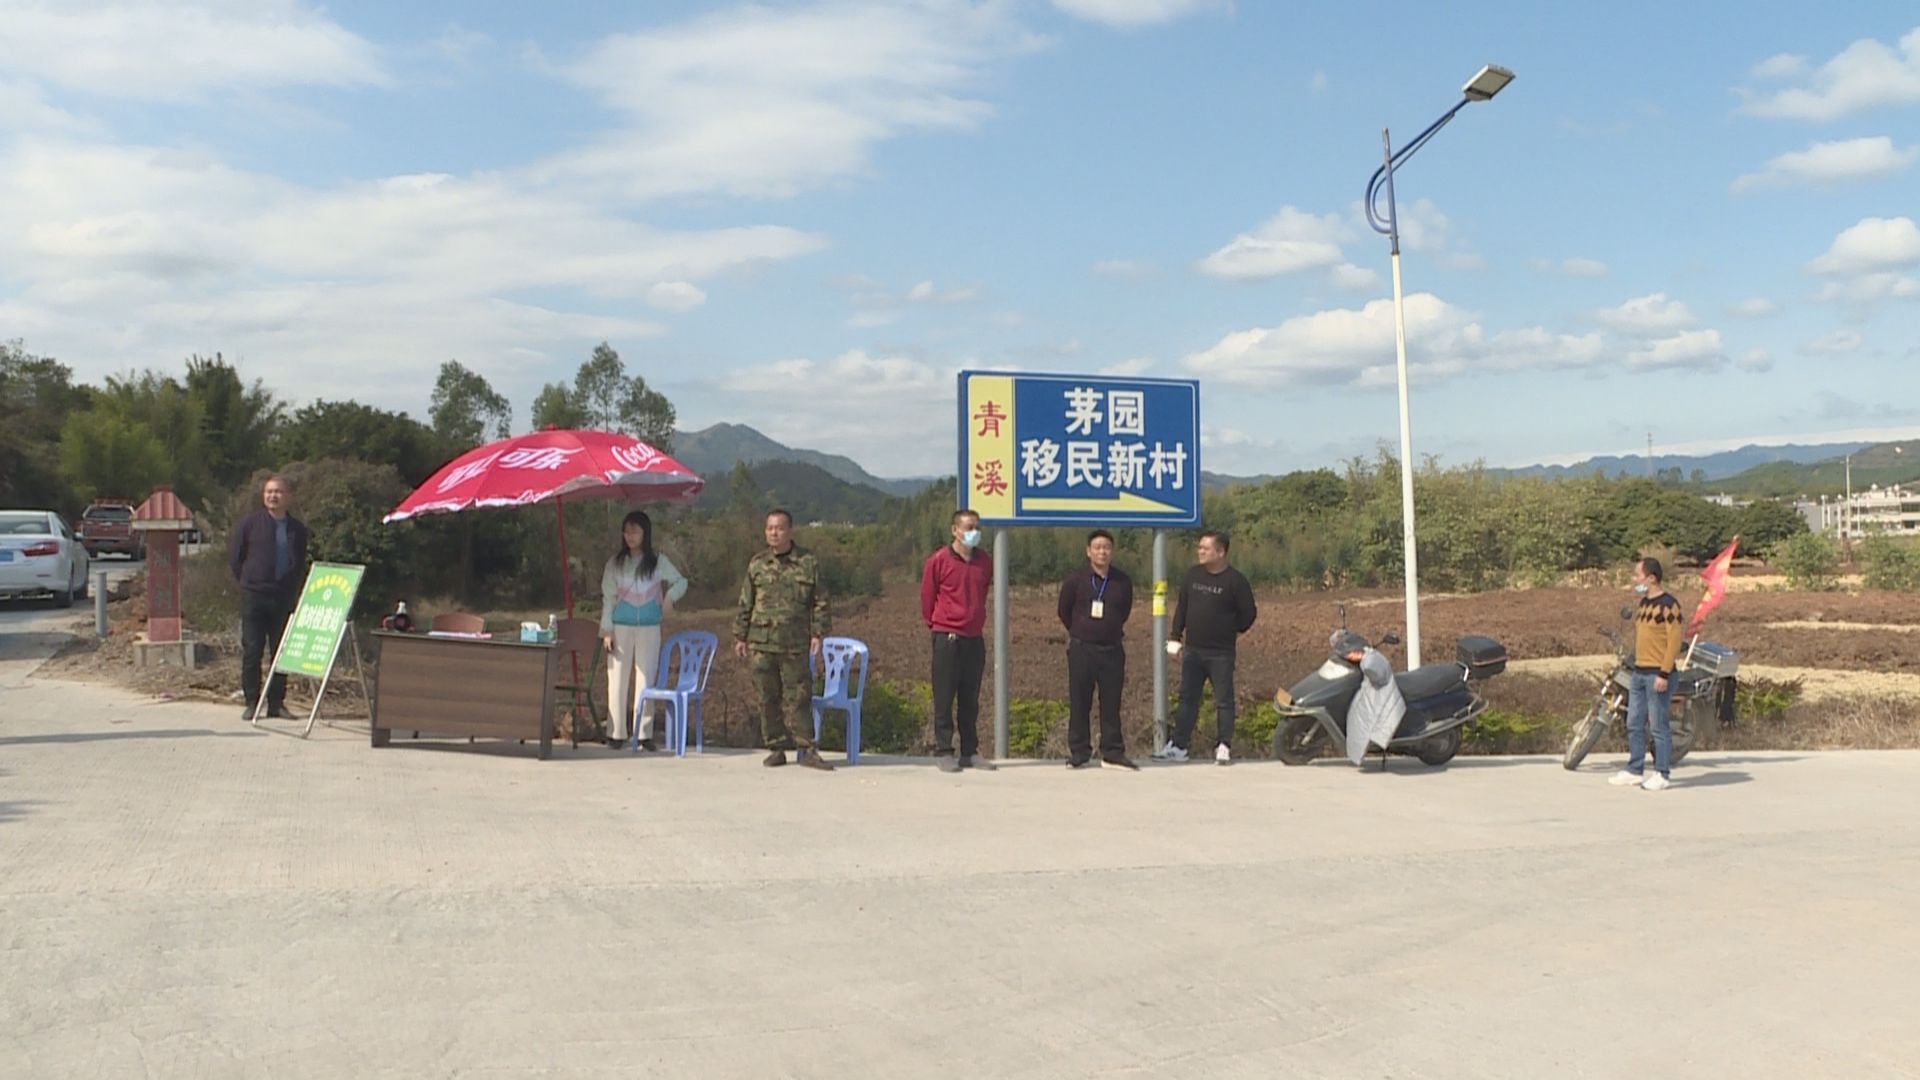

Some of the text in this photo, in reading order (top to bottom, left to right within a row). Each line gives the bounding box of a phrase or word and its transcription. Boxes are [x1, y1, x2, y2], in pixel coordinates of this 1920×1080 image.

[1063, 386, 1145, 437] 茅园
[610, 442, 659, 472] Coca
[973, 400, 1009, 497] 青溪
[1020, 438, 1188, 490] 移民新村
